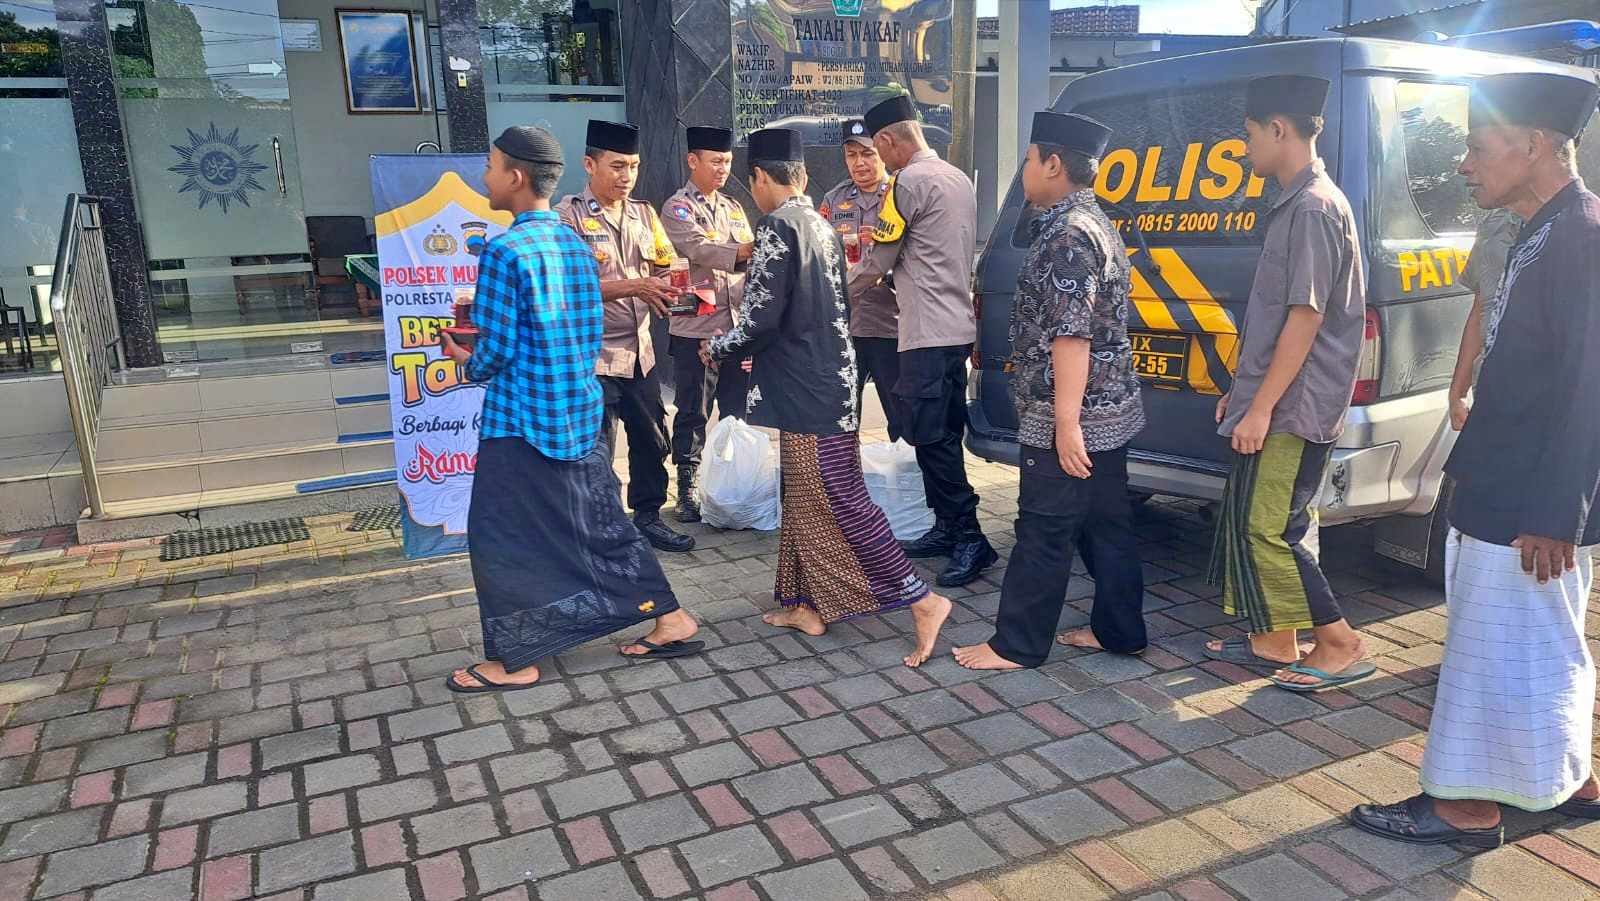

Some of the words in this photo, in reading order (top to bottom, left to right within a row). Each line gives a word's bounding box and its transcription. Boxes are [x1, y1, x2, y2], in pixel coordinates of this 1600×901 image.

[793, 18, 844, 41] TANAH
[849, 20, 901, 42] WAKAF
[737, 44, 769, 57] WAKIF
[738, 60, 775, 71] NAZHIR
[739, 103, 805, 115] PERUNTUKAN
[740, 118, 765, 128] LUAS
[1136, 213, 1175, 232] 0815
[1177, 212, 1219, 232] 2000
[1224, 211, 1256, 231] 110
[383, 265, 447, 286] POLSEK
[385, 291, 454, 305] POLRESTA
[398, 414, 466, 436] Berbagi
